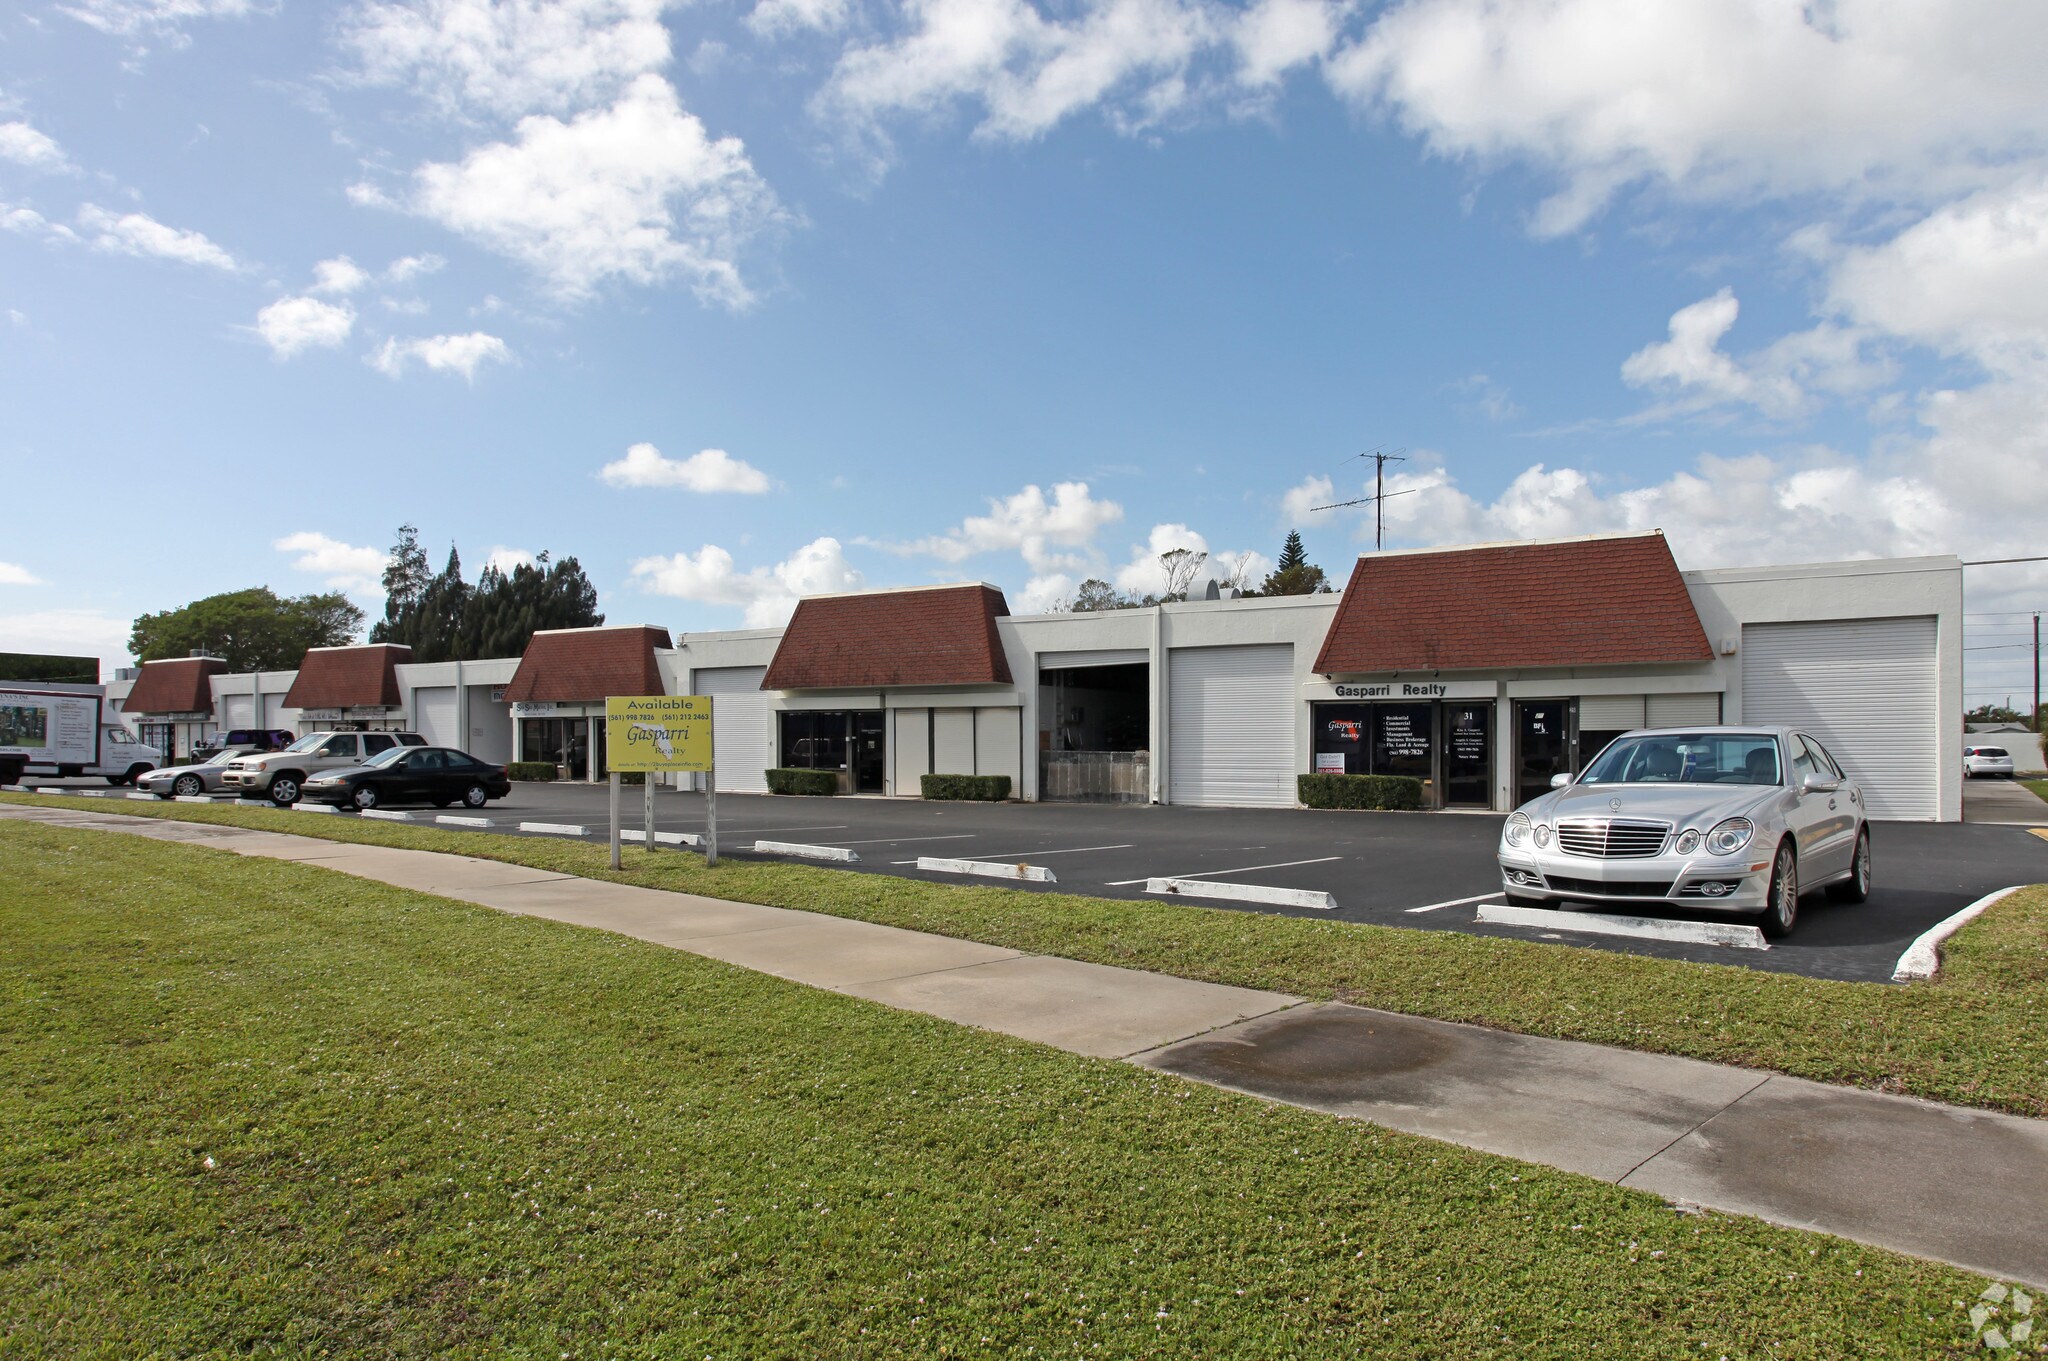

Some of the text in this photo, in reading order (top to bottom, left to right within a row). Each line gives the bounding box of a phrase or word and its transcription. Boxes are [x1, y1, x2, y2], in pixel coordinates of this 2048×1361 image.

[1335, 684, 1447, 698] Gasparri Realty
[627, 699, 693, 709] Available
[661, 714, 679, 722] (561)
[1463, 712, 1473, 720] 31
[1328, 721, 1362, 732] Gasparri
[627, 725, 690, 747] Gasparri
[655, 748, 686, 757] Realty
